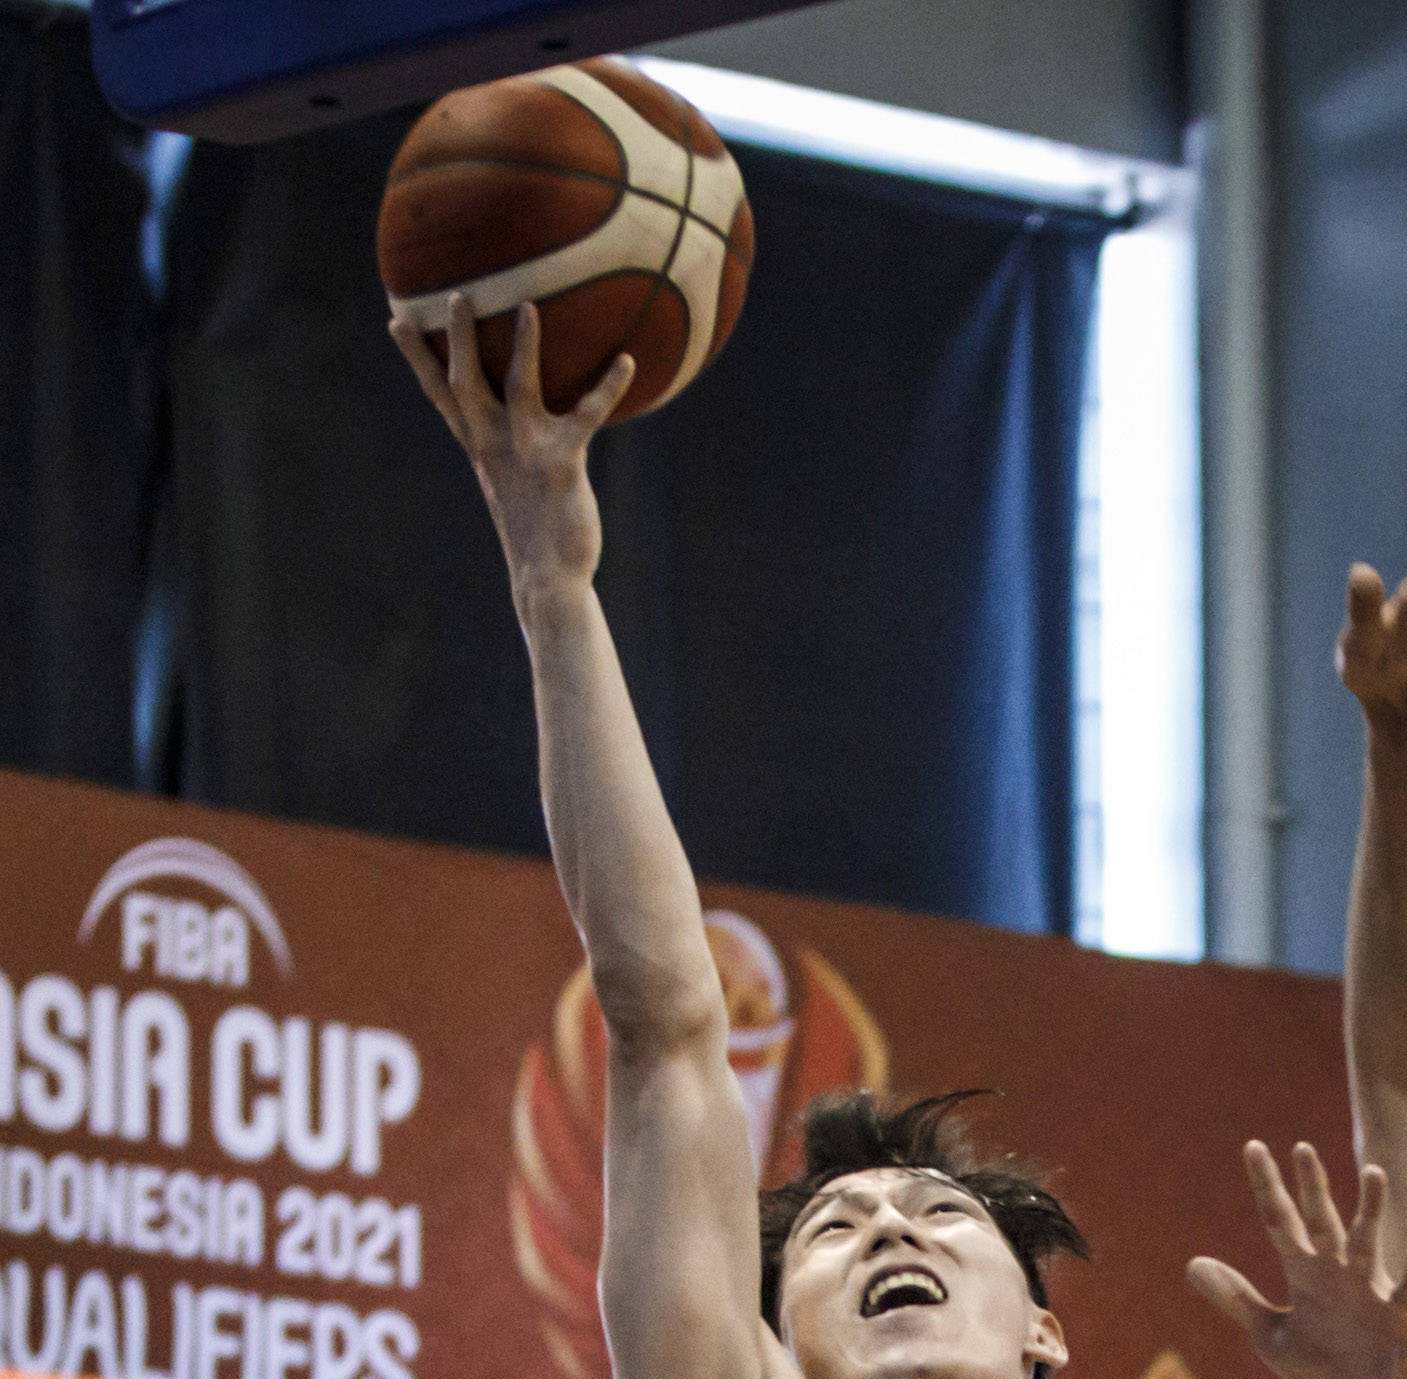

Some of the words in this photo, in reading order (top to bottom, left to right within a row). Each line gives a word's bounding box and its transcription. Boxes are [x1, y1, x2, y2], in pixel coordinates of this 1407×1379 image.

[121, 893, 250, 988] FIBA
[0, 977, 191, 1147] SIA
[211, 1006, 421, 1176] CUP
[0, 1146, 265, 1269] DONESIA
[276, 1186, 421, 1290] 2021
